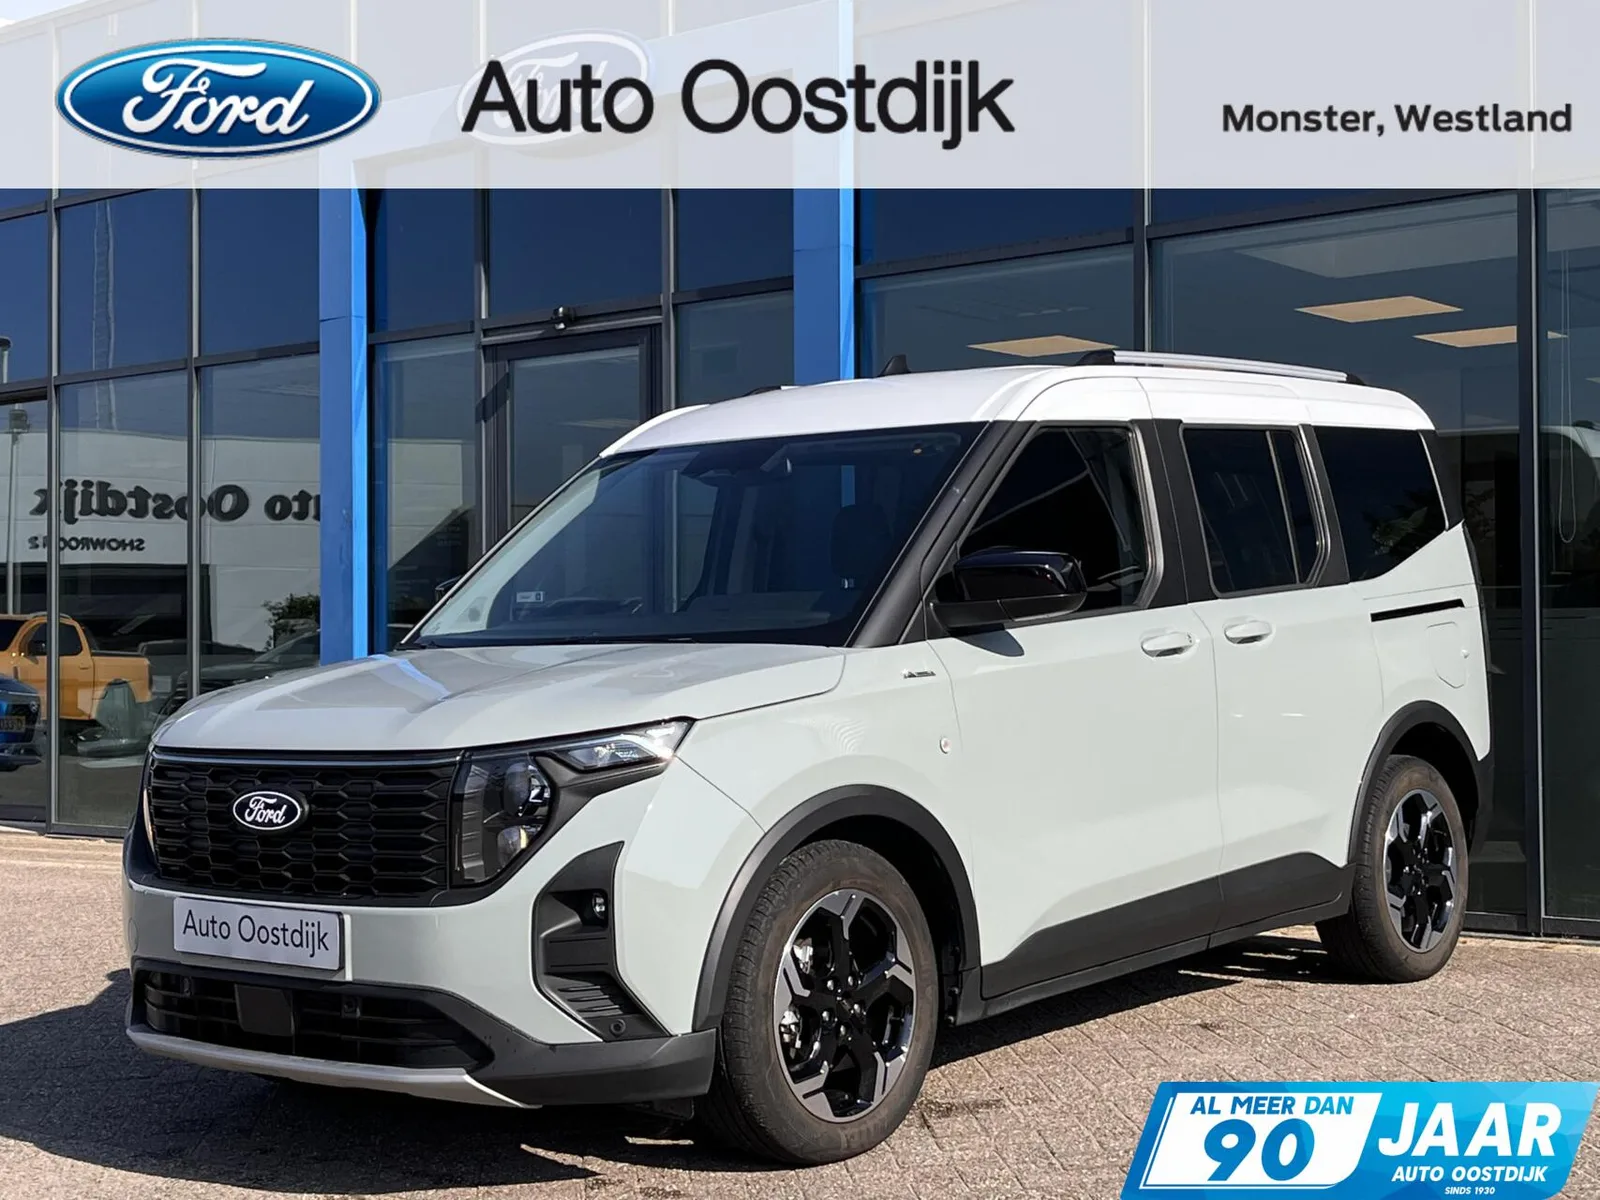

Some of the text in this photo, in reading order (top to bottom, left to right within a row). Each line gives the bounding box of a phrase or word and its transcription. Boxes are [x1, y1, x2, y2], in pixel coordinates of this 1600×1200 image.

[244, 796, 287, 824] Ford
[182, 909, 329, 958] Auto Oostdijk
